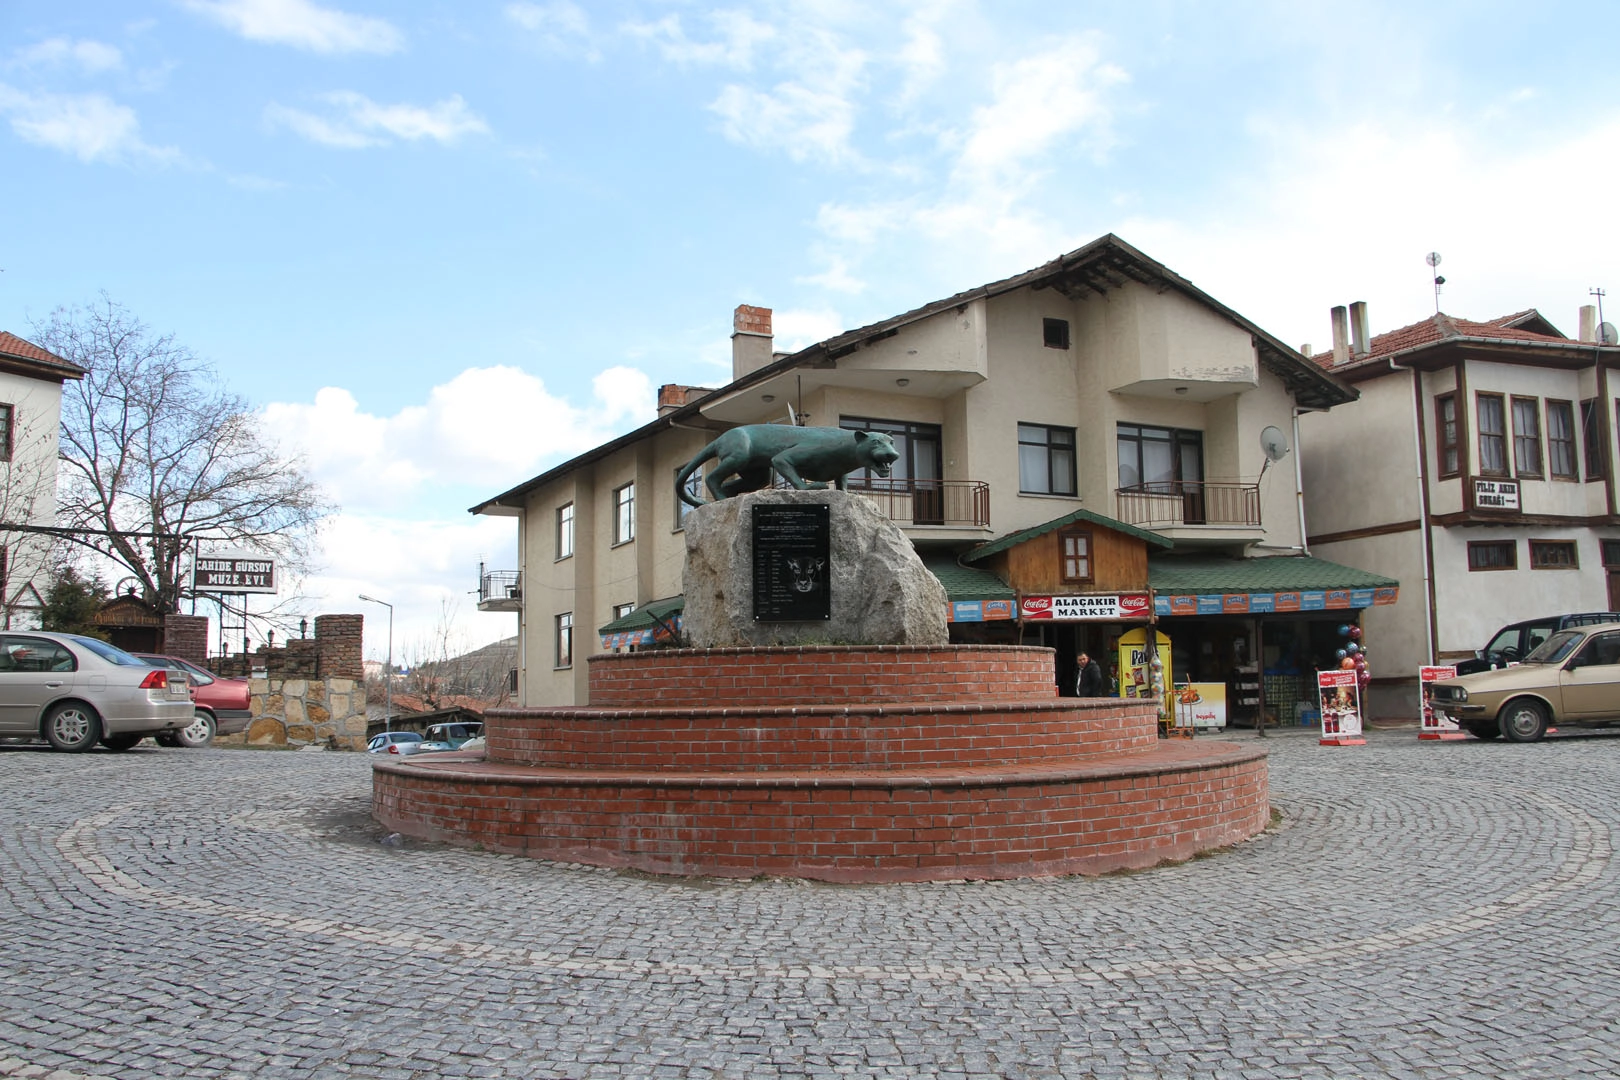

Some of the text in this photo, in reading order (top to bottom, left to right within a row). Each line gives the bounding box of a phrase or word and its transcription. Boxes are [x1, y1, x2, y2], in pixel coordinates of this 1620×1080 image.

[197, 560, 271, 573] CAHİDE GÜRSOY
[1055, 599, 1116, 607] ALAÇAKIR
[1058, 608, 1115, 616] MARKET
